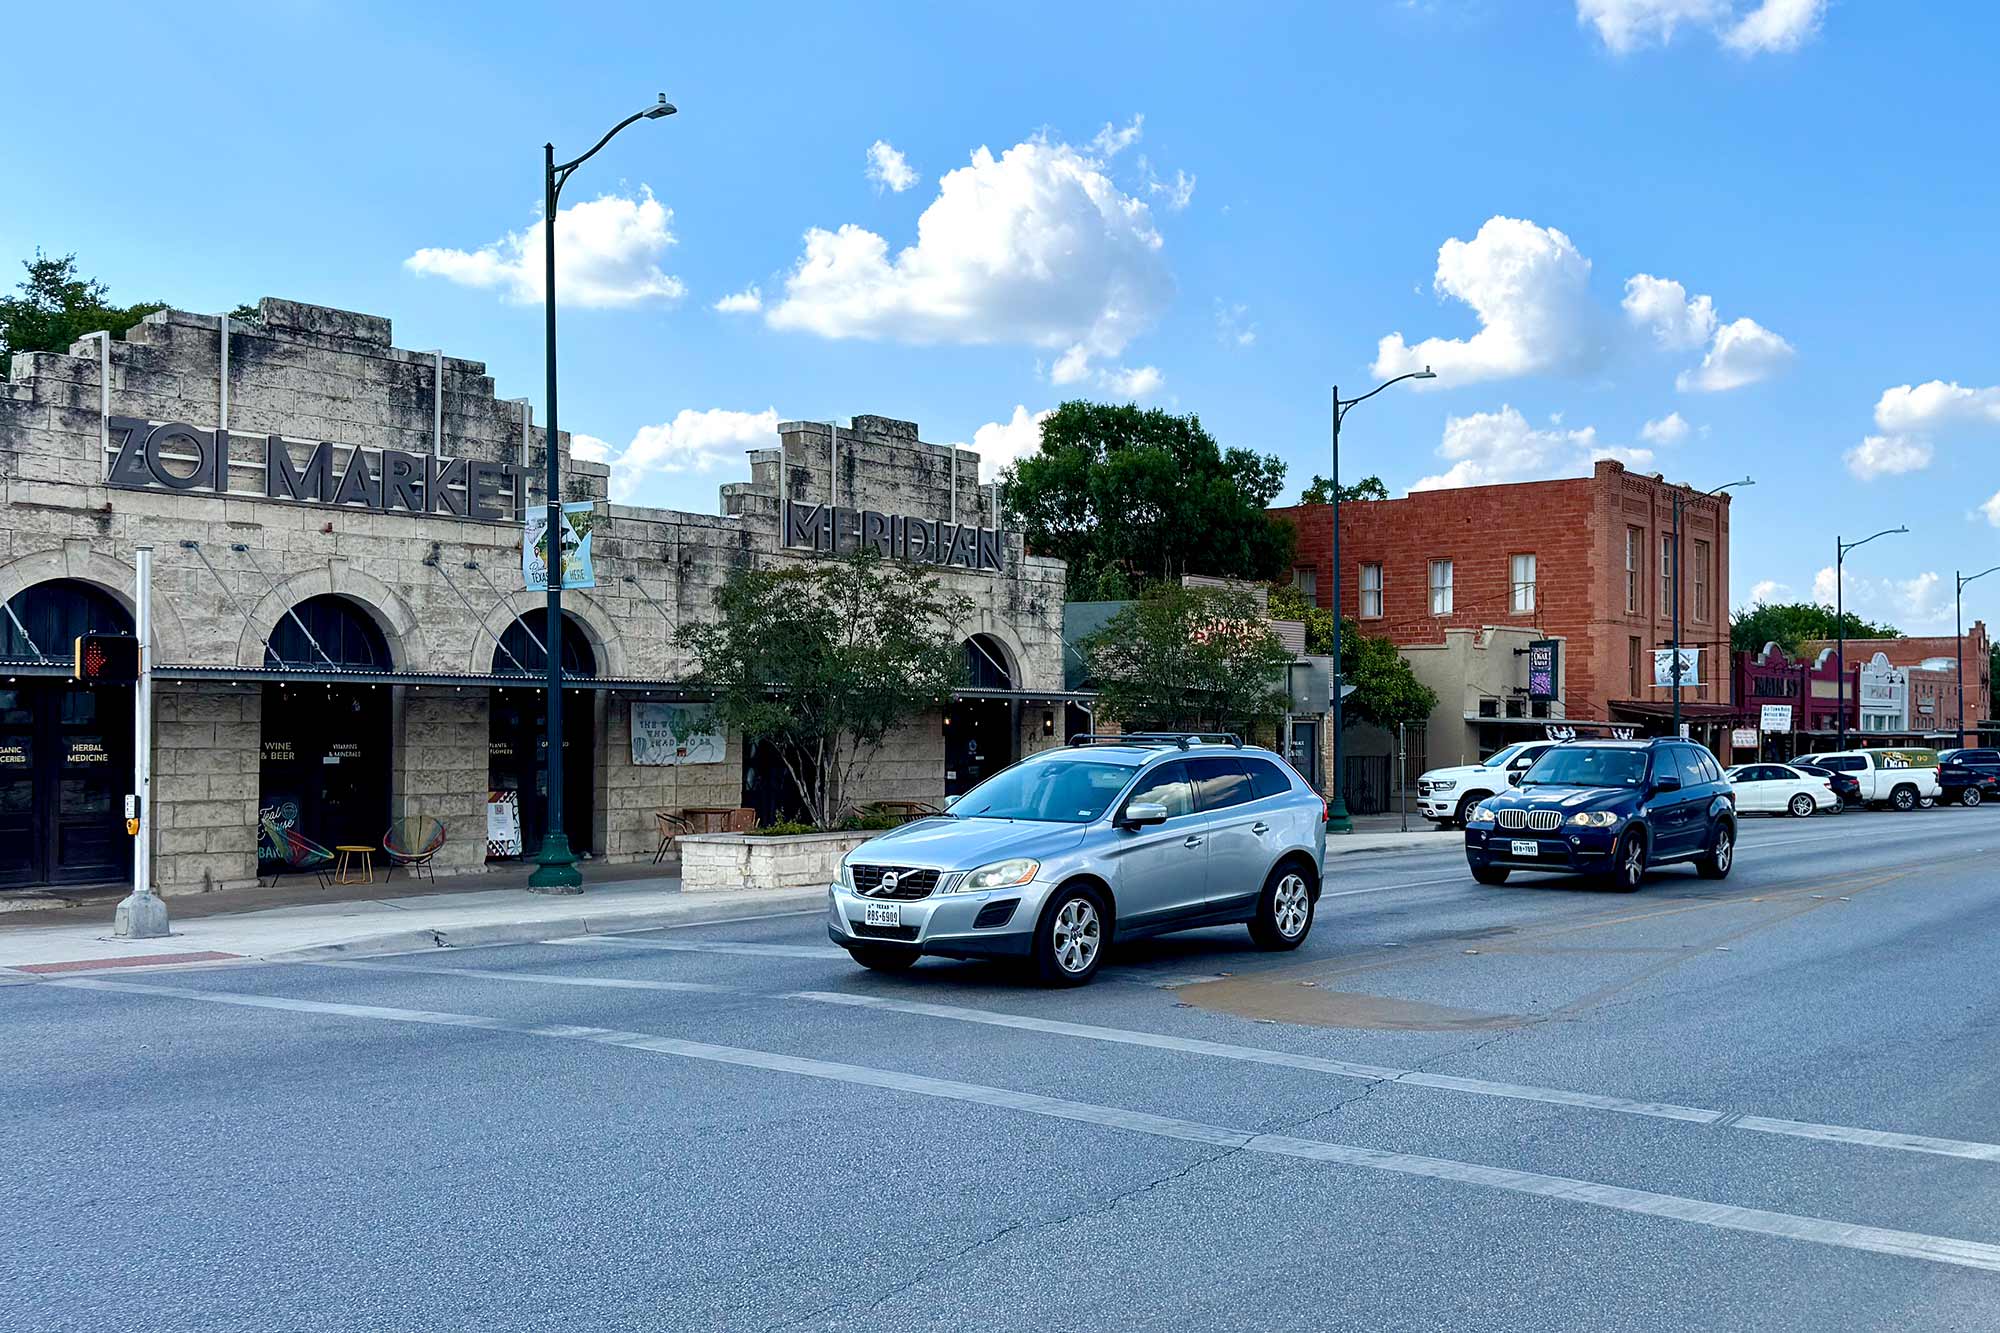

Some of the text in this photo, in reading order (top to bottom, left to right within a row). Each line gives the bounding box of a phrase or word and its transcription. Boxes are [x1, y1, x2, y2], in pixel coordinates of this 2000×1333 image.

[107, 416, 536, 520] ZOI MARKET
[786, 501, 1003, 571] MERIDIAN
[72, 743, 104, 752] HERBAL
[264, 742, 292, 750] WINE
[67, 753, 109, 762] MEDICINE
[270, 751, 295, 760] BEER
